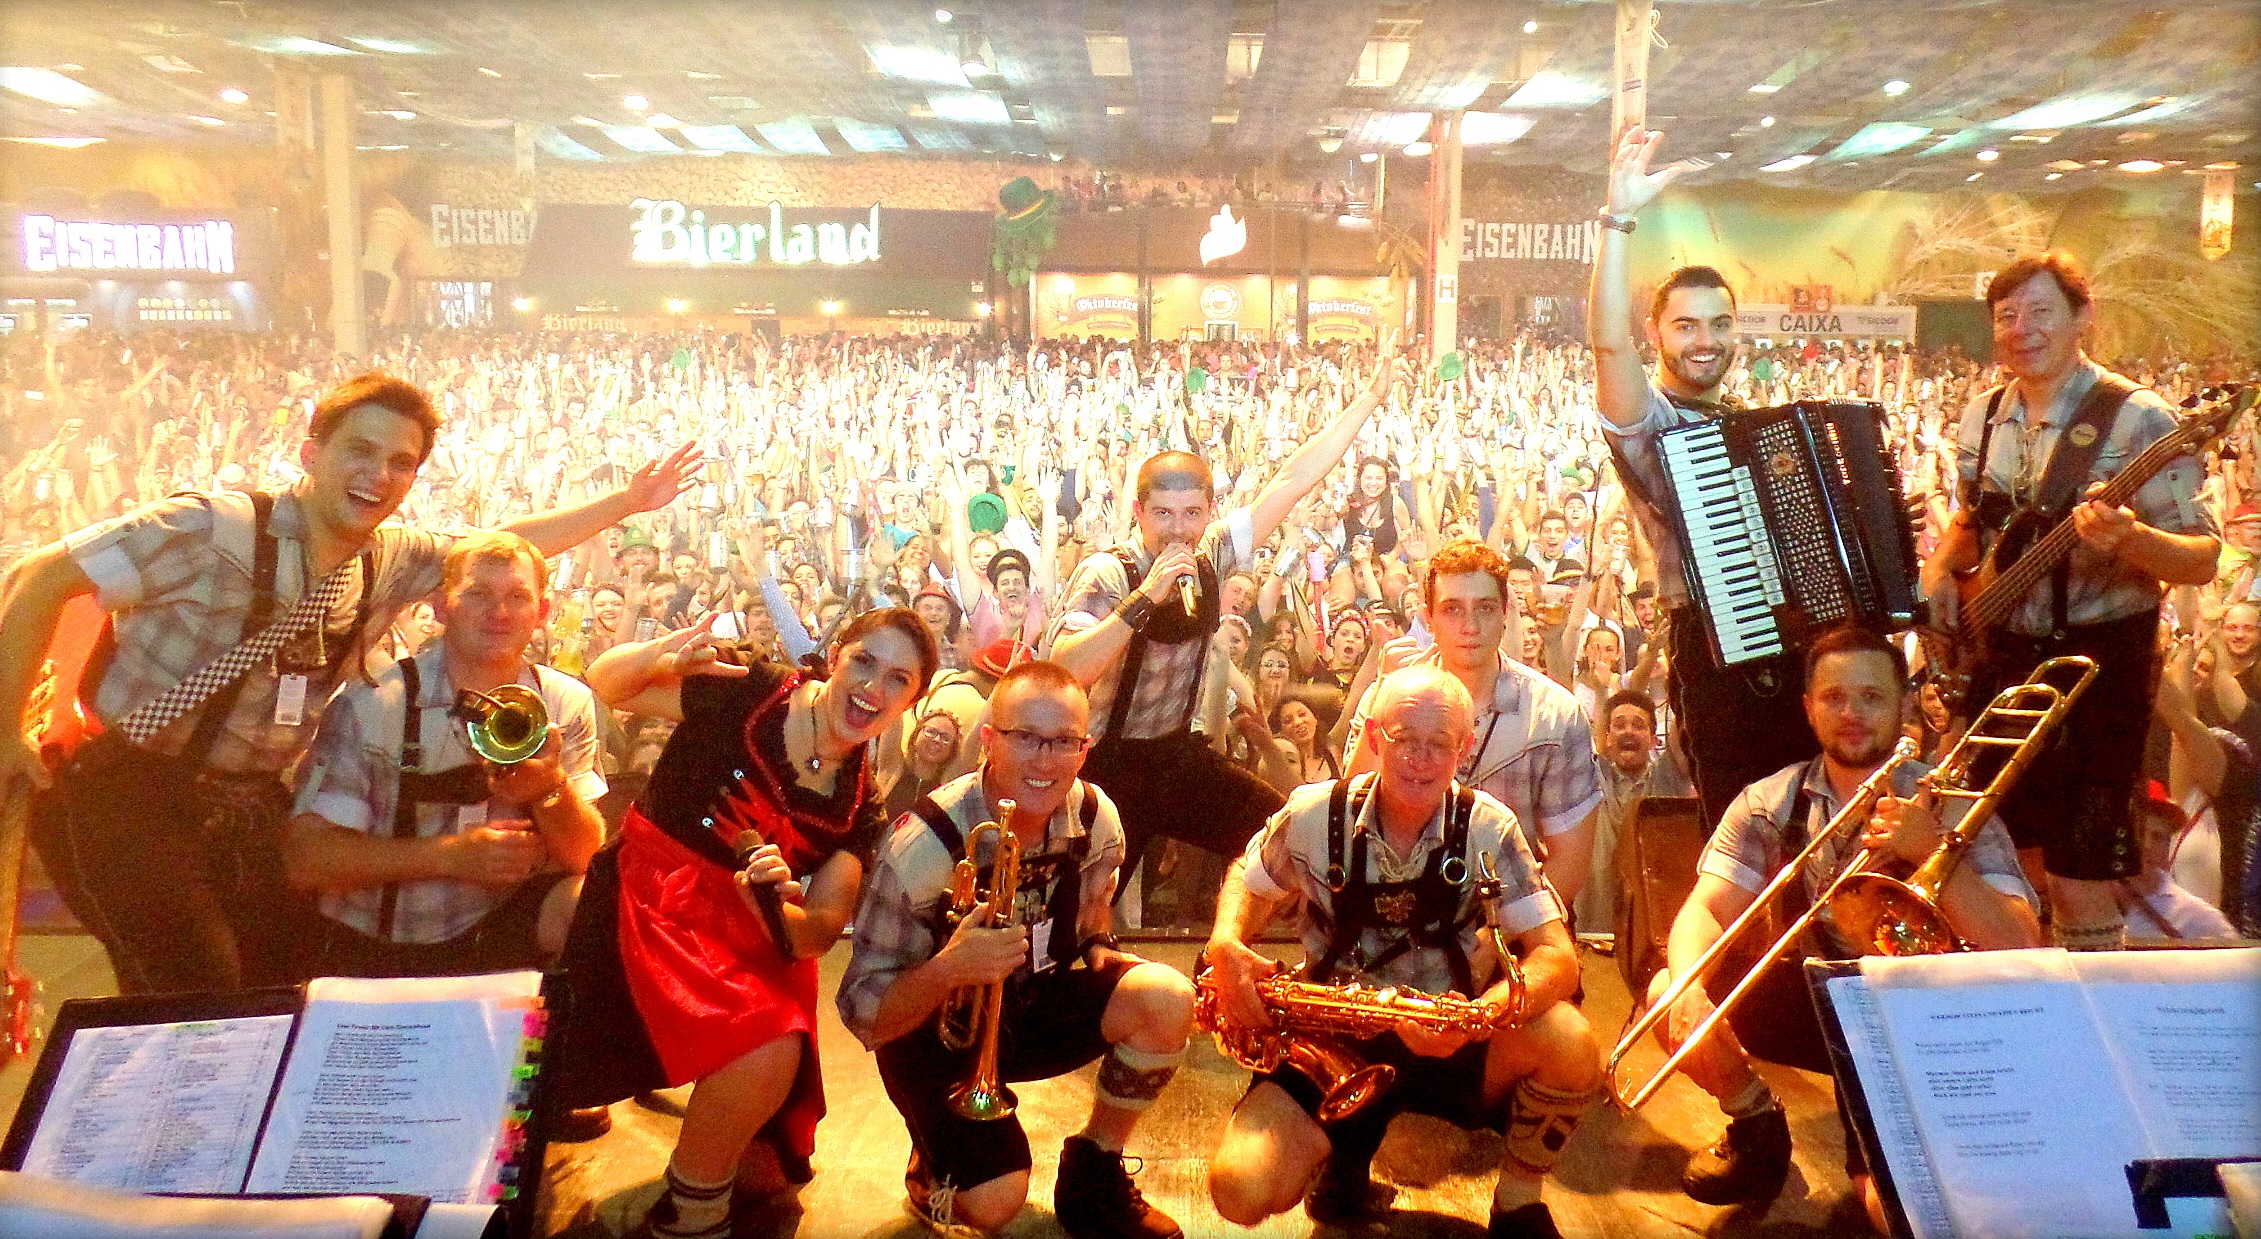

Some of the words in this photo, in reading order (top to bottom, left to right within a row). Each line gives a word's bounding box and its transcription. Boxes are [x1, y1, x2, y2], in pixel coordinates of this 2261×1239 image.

[23, 214, 235, 273] EISENBAHN
[630, 197, 881, 267] Bierland
[1460, 218, 1601, 264] EISENBAHN
[1779, 314, 1843, 332] CAIXA
